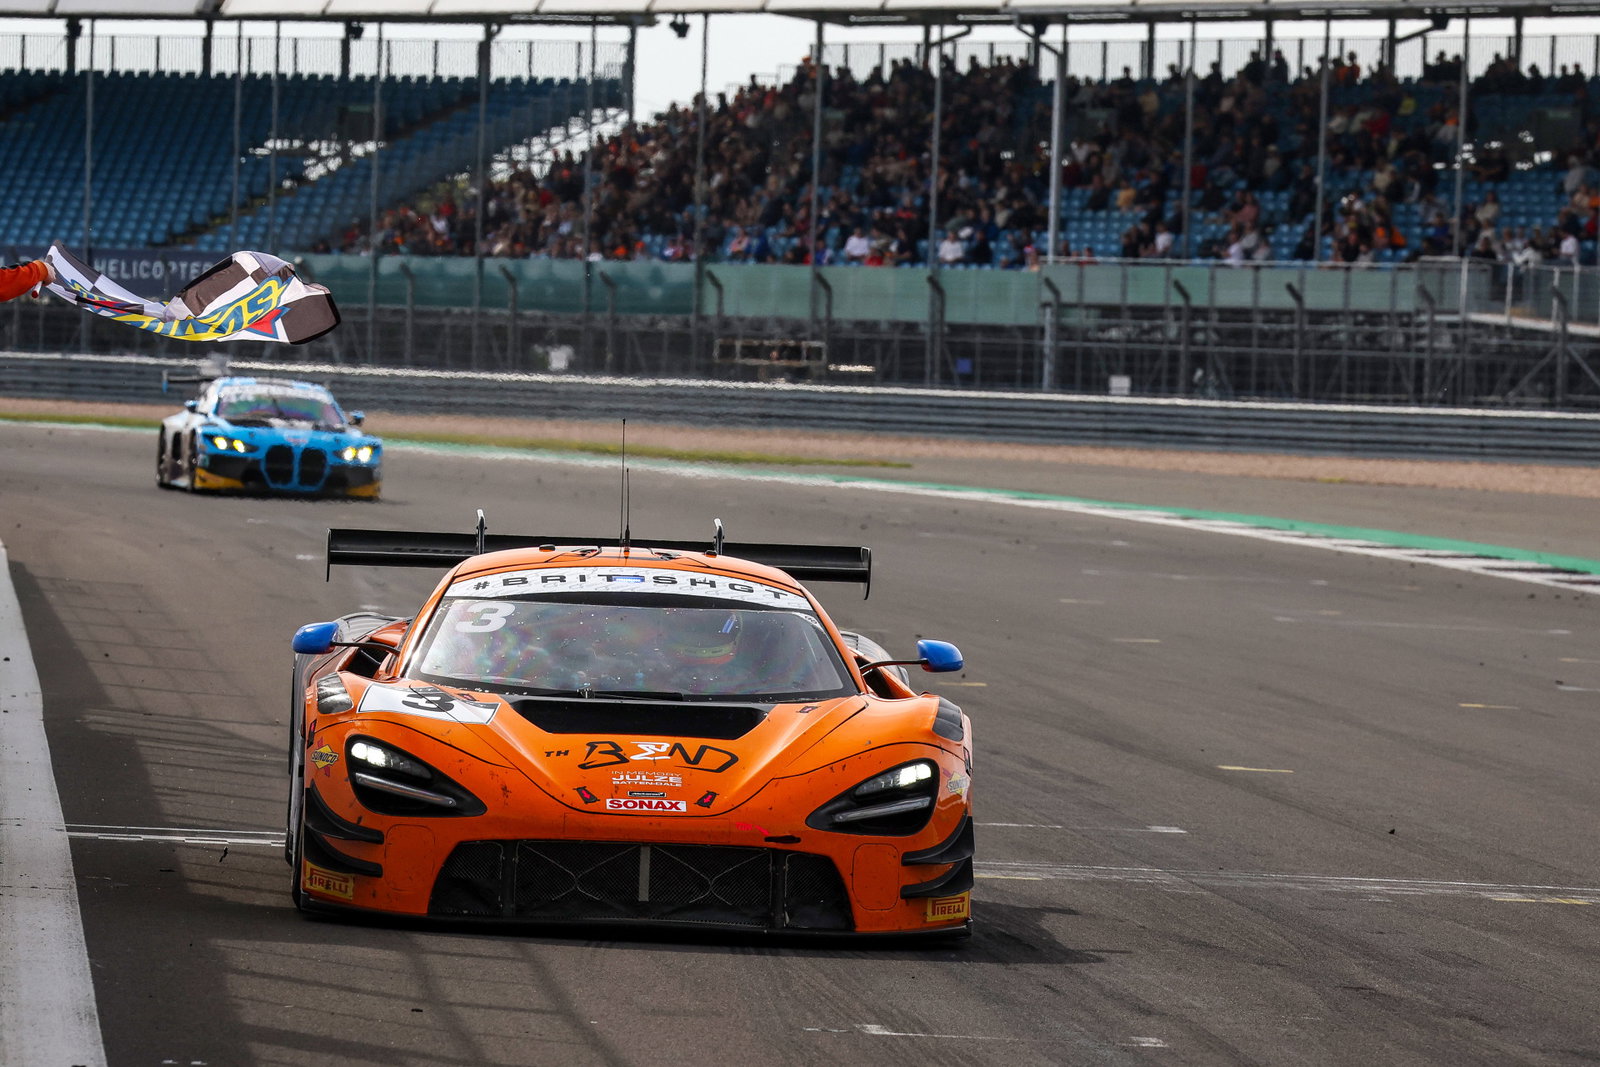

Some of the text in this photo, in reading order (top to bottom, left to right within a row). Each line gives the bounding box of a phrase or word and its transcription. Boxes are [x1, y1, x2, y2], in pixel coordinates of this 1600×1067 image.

[473, 574, 788, 600] #BRITSHGT
[456, 601, 516, 633] 3
[402, 692, 457, 713] 3
[311, 750, 338, 764] SUNOCO
[611, 774, 683, 784] JULZE
[608, 800, 683, 811] SONAX
[309, 867, 350, 894] PIRELLI
[931, 896, 966, 916] PIRELLI
